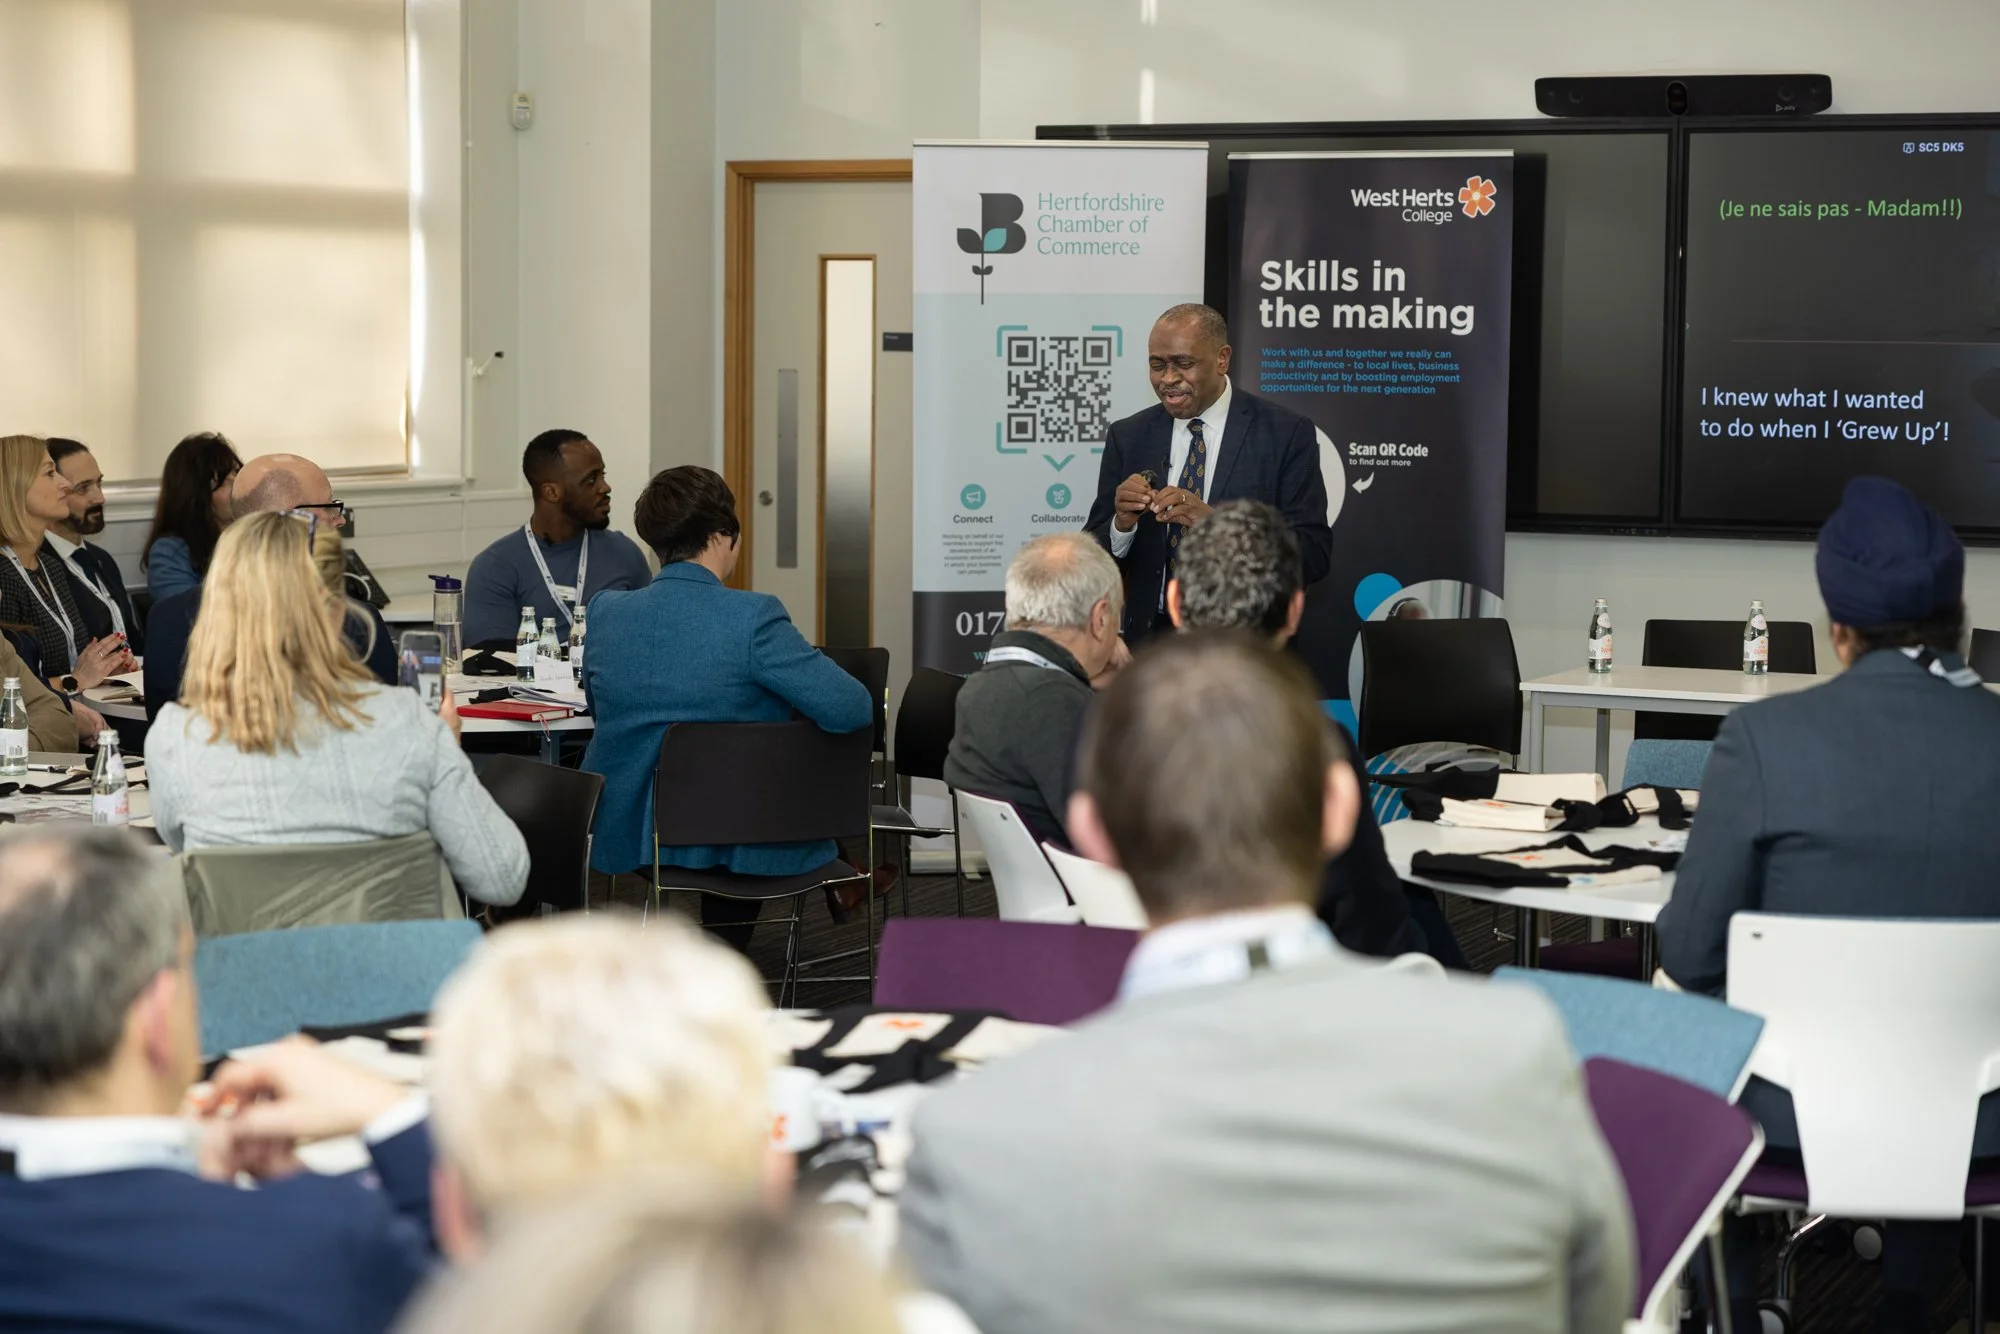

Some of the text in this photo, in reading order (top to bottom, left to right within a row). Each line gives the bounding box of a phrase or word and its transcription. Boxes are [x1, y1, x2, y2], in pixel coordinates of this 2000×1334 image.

[1918, 142, 1964, 153] SC5 DK5
[1038, 192, 1165, 212] Hertfordshire
[1350, 188, 1455, 207] West Herts
[1401, 208, 1453, 225] College
[1719, 199, 1744, 221] (Je
[1750, 204, 1773, 217] ne
[1778, 199, 1812, 217] sais
[1817, 203, 1849, 221] pas
[1867, 198, 1963, 221] Madam!!)
[1037, 214, 1150, 233] Chamber of
[1037, 236, 1140, 255] Commerce
[1260, 259, 1406, 292] Skills in
[1259, 296, 1475, 336] the making
[1260, 347, 1452, 360] Work with us and together we really can
[1260, 360, 1287, 369] make
[1288, 361, 1295, 369] a
[1297, 360, 1345, 369] difference
[1353, 361, 1364, 369] to
[1366, 360, 1390, 370] local
[1391, 361, 1416, 371] lives,
[1418, 361, 1460, 371] business
[1260, 372, 1461, 384] productivity and by boosting employment
[1260, 383, 1436, 395] opportunities for the next generation
[1701, 386, 1924, 410] I knew what I wanted
[1699, 418, 1722, 437] to
[1727, 417, 1754, 438] do
[1759, 418, 1817, 439] when
[1823, 420, 1829, 439] I
[1348, 442, 1429, 457] Scan QR Code
[1349, 458, 1358, 466] to
[1359, 457, 1375, 466] find
[1391, 459, 1412, 467] more
[952, 514, 994, 524] Connect
[1031, 514, 1086, 523] Collaborate
